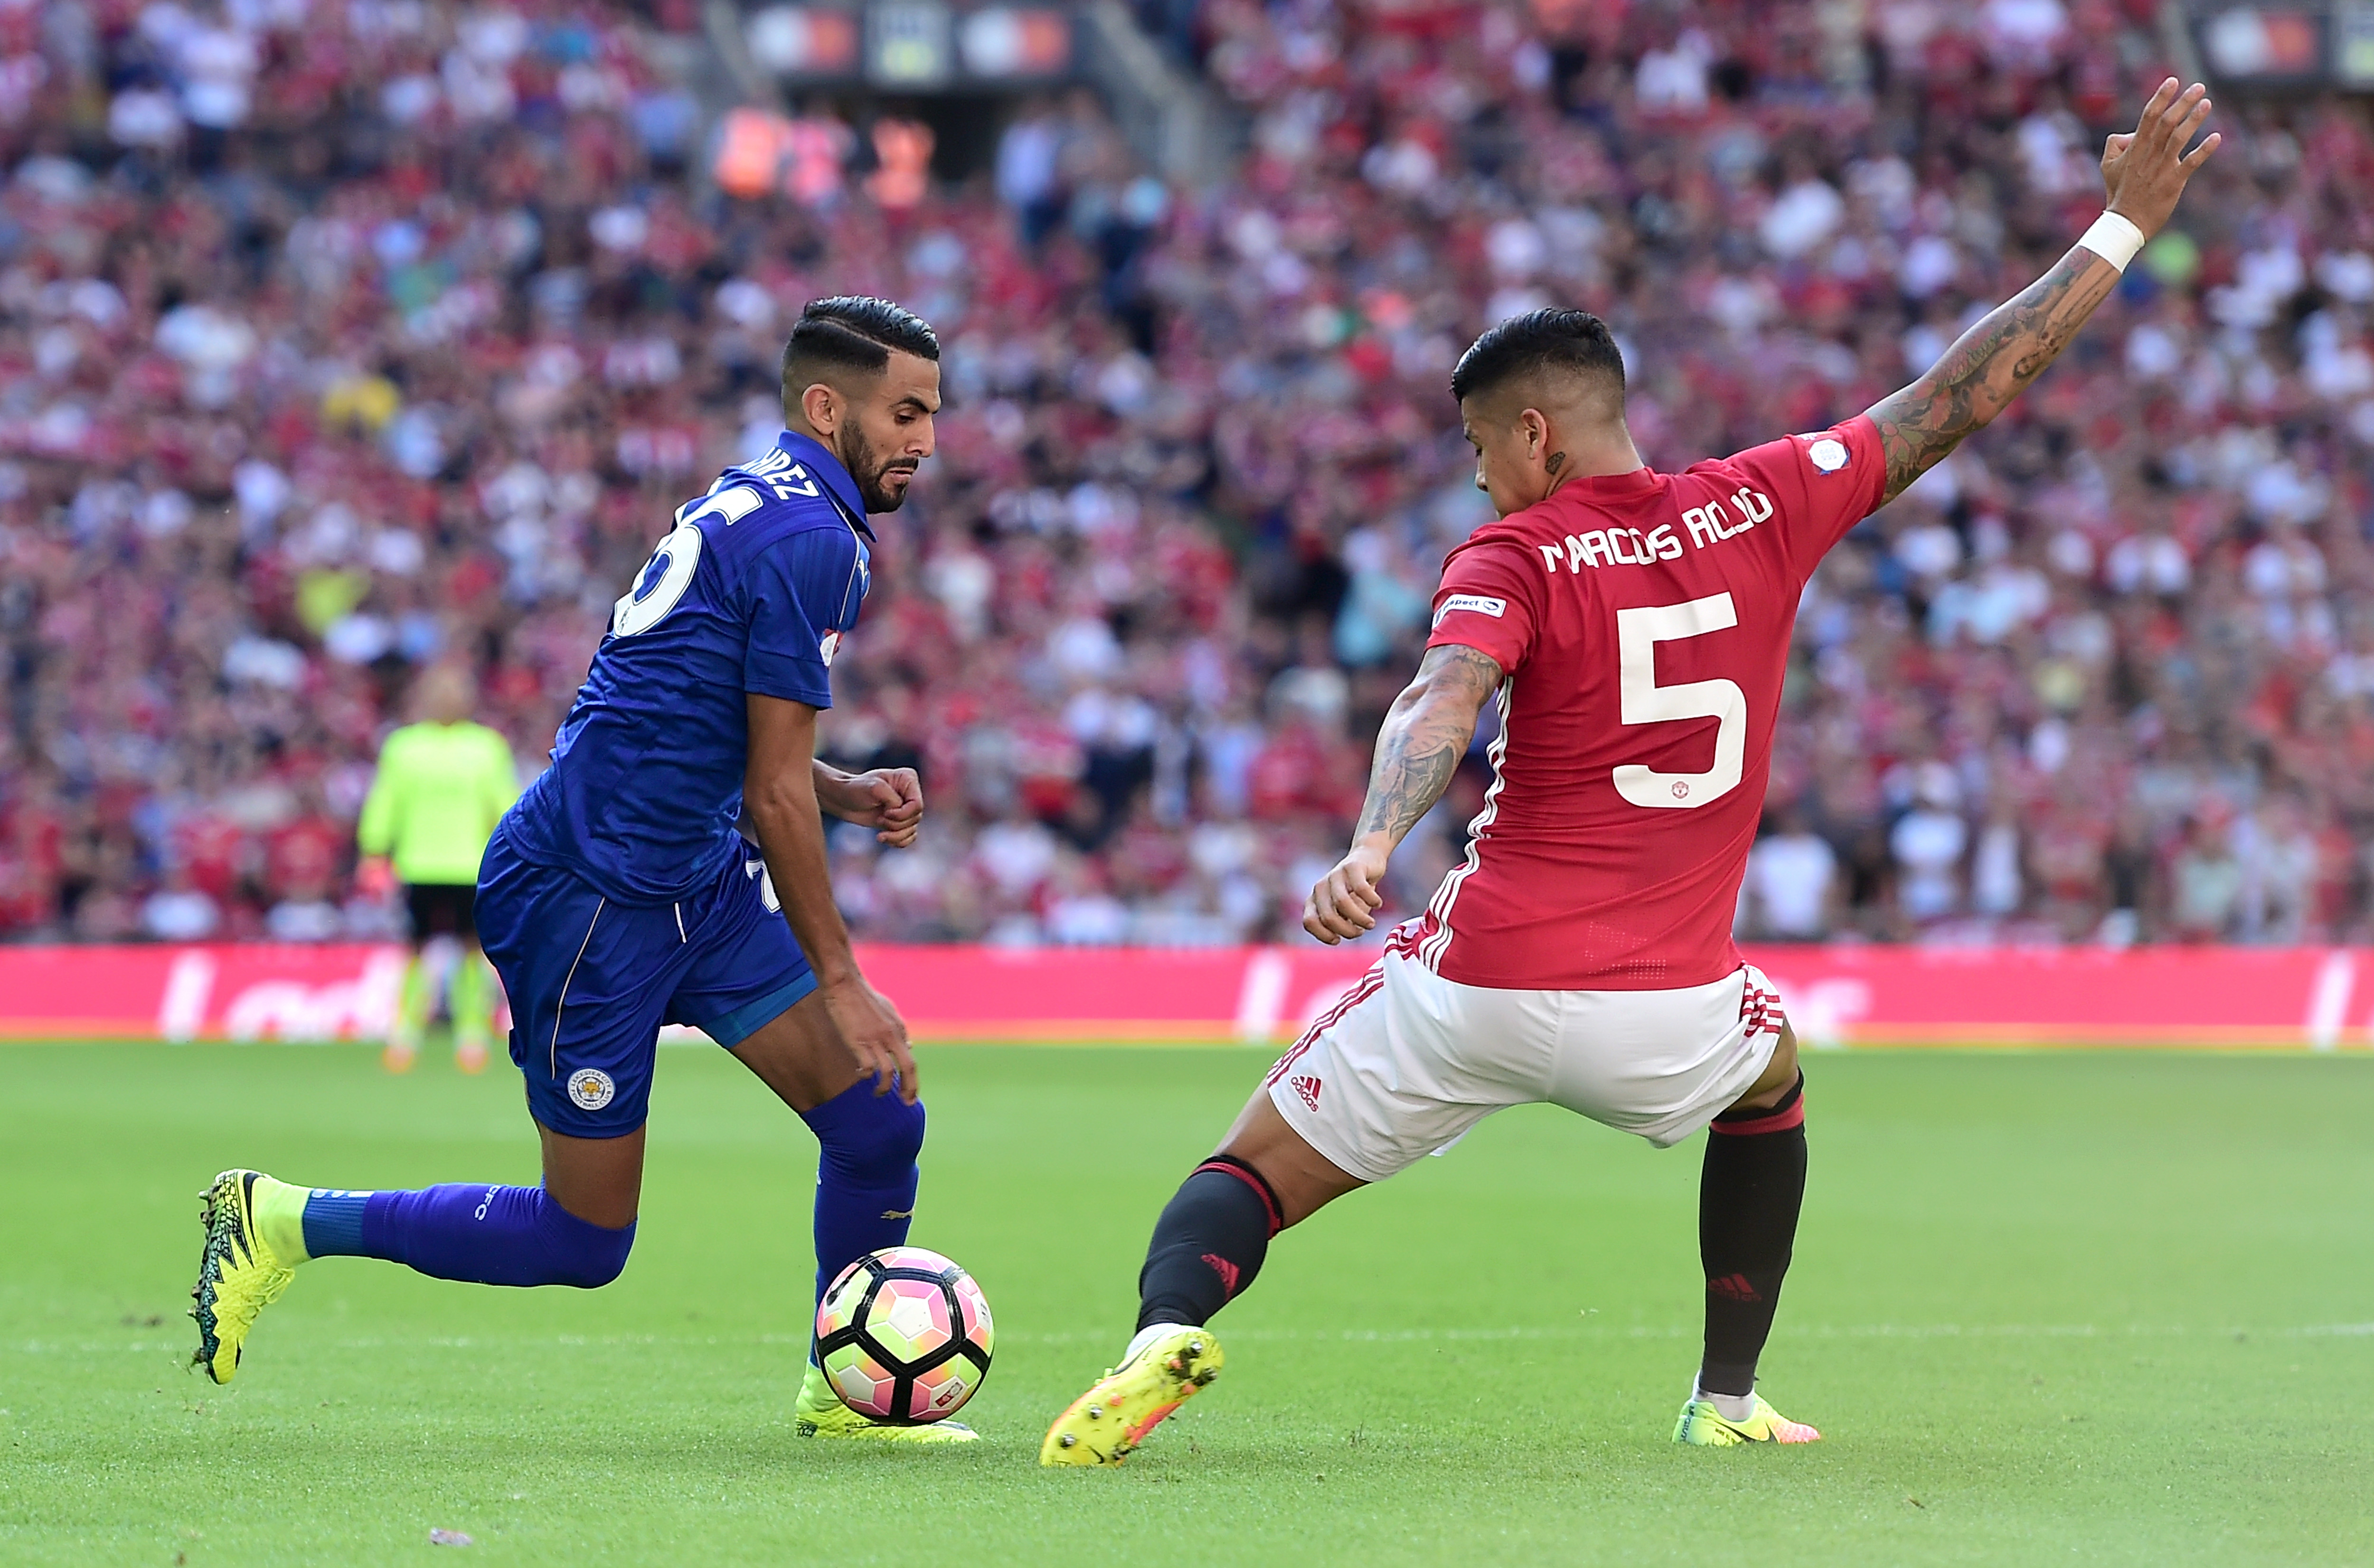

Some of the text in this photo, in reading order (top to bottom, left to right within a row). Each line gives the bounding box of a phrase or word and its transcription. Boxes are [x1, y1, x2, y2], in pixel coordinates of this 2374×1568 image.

[739, 446, 820, 500] HREZ
[1681, 487, 1773, 549] ROJO
[613, 477, 763, 639] 6
[1612, 591, 1747, 808] 5
[1290, 1076, 1319, 1113] adidas
